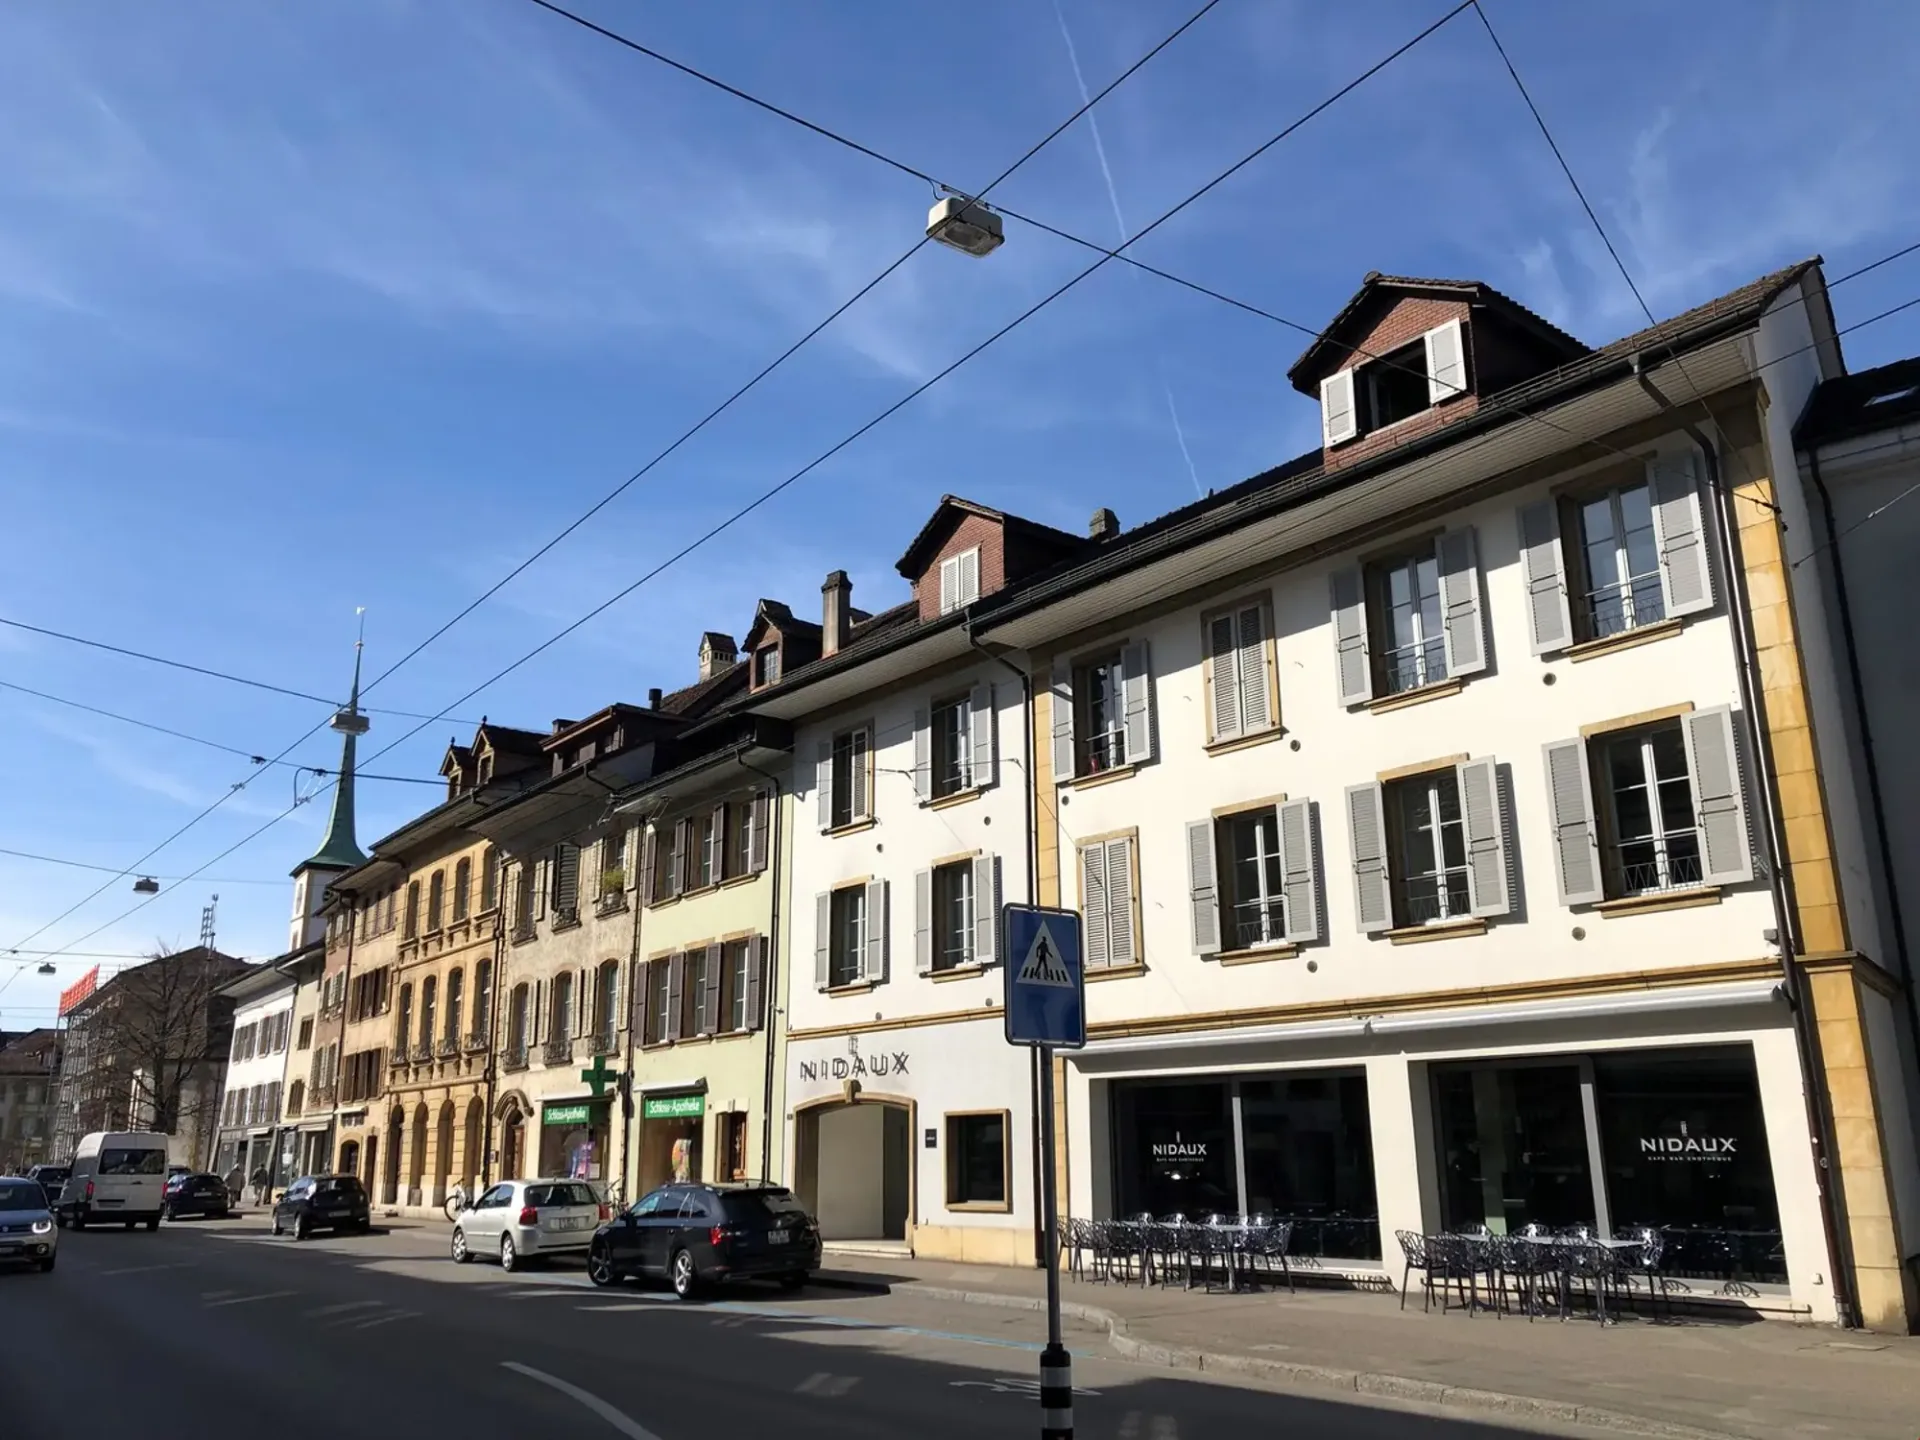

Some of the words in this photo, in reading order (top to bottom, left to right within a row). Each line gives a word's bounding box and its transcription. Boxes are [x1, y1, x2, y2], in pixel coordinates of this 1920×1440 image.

[800, 1051, 910, 1081] NIDAUX
[1152, 1143, 1207, 1155] NIDAUX
[1640, 1138, 1737, 1152] NIDAUX
